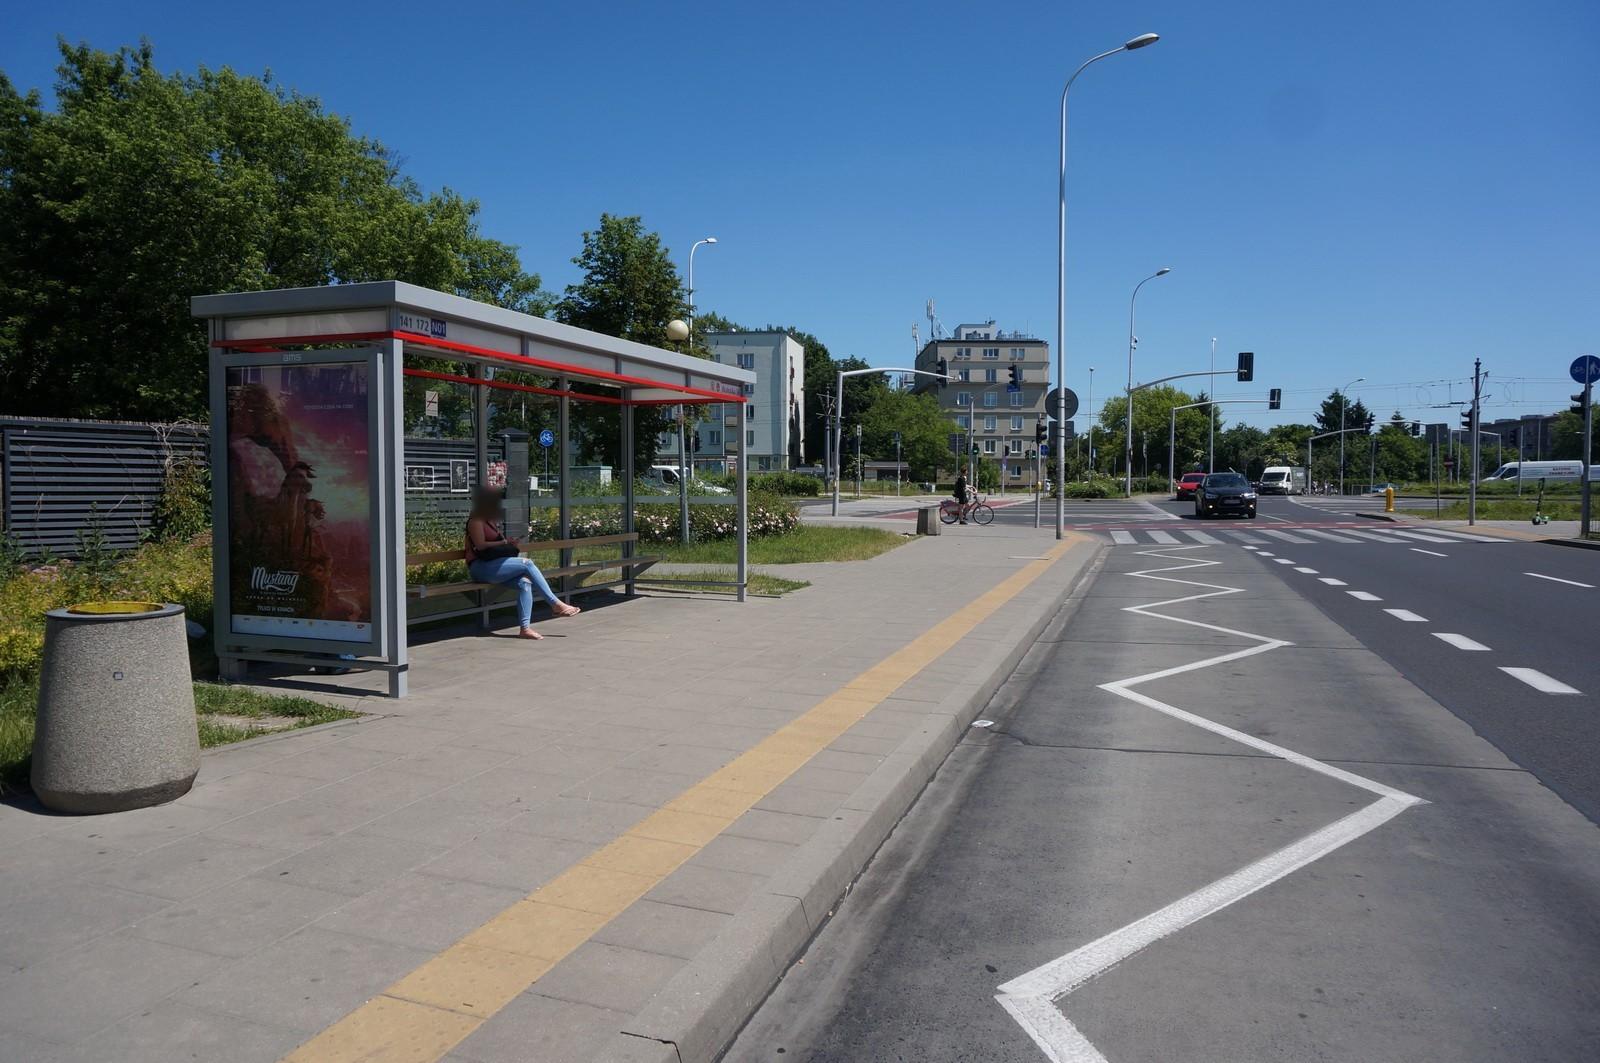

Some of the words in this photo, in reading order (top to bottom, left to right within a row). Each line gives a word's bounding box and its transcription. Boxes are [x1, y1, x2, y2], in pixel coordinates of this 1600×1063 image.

[400, 315, 413, 329] 141
[416, 319, 430, 332] 172
[431, 320, 446, 336] N01
[251, 566, 300, 593] Mustang
